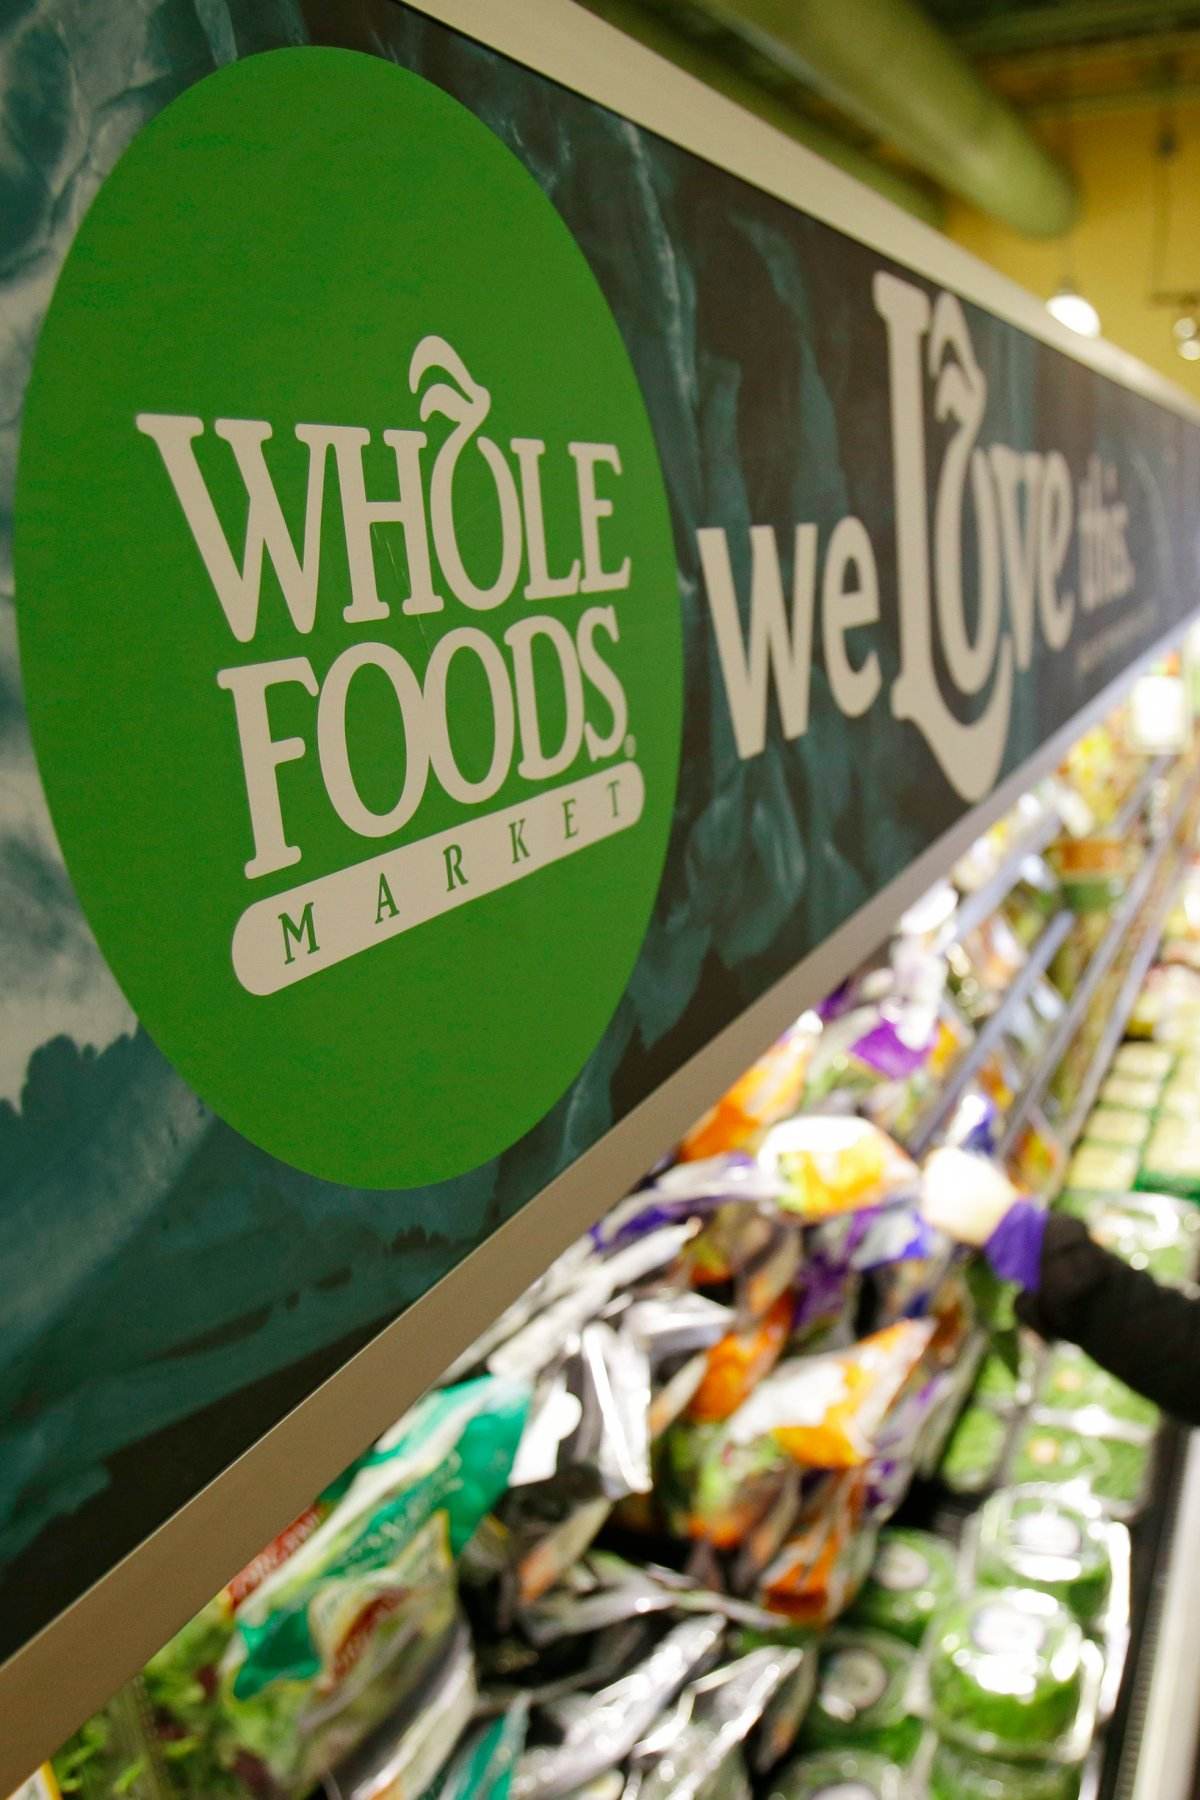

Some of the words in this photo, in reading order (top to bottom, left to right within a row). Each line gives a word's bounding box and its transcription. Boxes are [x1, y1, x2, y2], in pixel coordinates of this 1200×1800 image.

[135, 383, 631, 643] WHOLE
[697, 516, 882, 760] we
[873, 270, 1076, 802] Love
[217, 606, 629, 879] FOODS
[278, 780, 623, 964] MARKET
